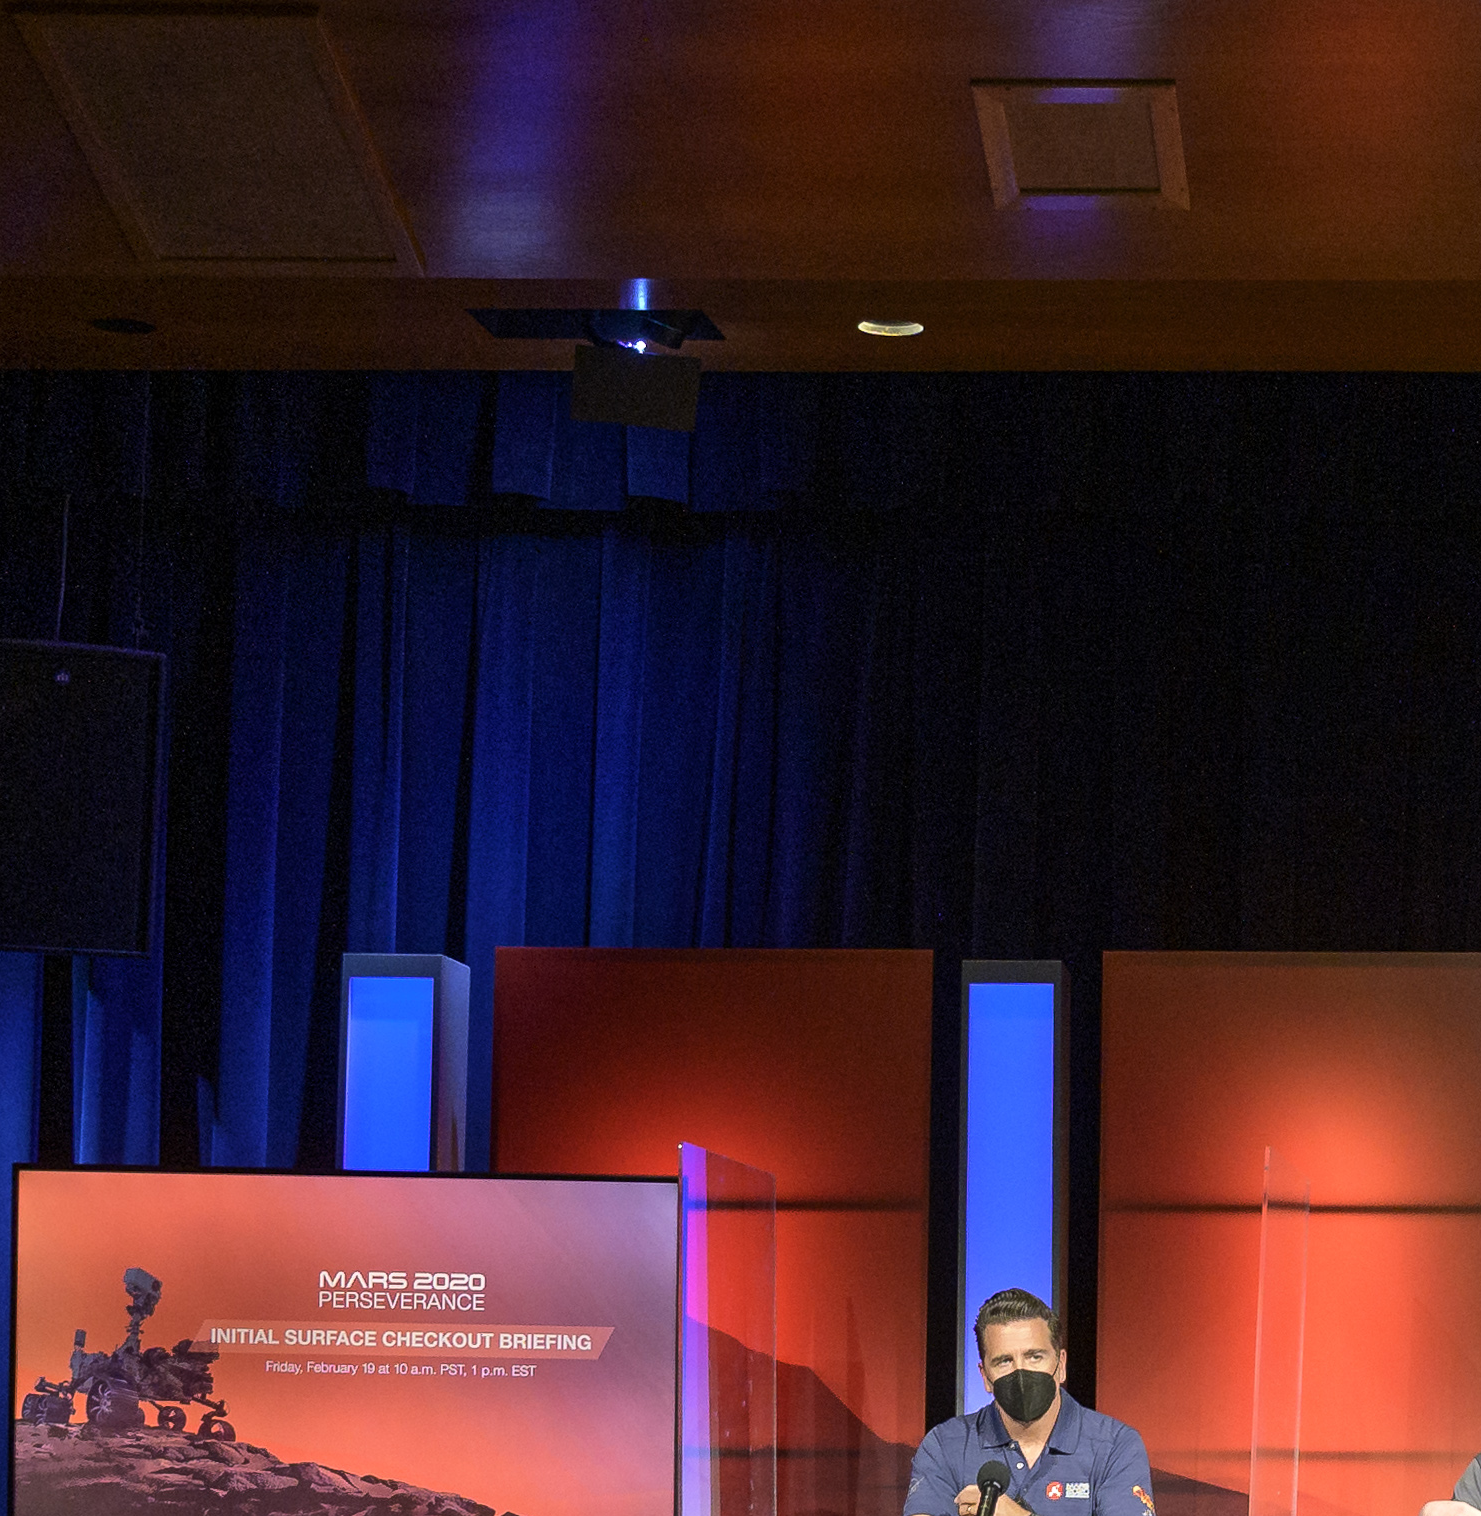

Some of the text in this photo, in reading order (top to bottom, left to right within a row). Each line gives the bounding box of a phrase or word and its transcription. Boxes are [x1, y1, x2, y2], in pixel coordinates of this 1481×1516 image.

[319, 1271, 486, 1291] MARS 2020
[319, 1291, 485, 1311] PERSEVERANCE
[210, 1328, 592, 1350] INITIAL SURFACE CHECKOUT BRIEFING
[266, 1361, 537, 1378] Friday, February 19 at 10 a.m. PST, 1 p.m. EST
